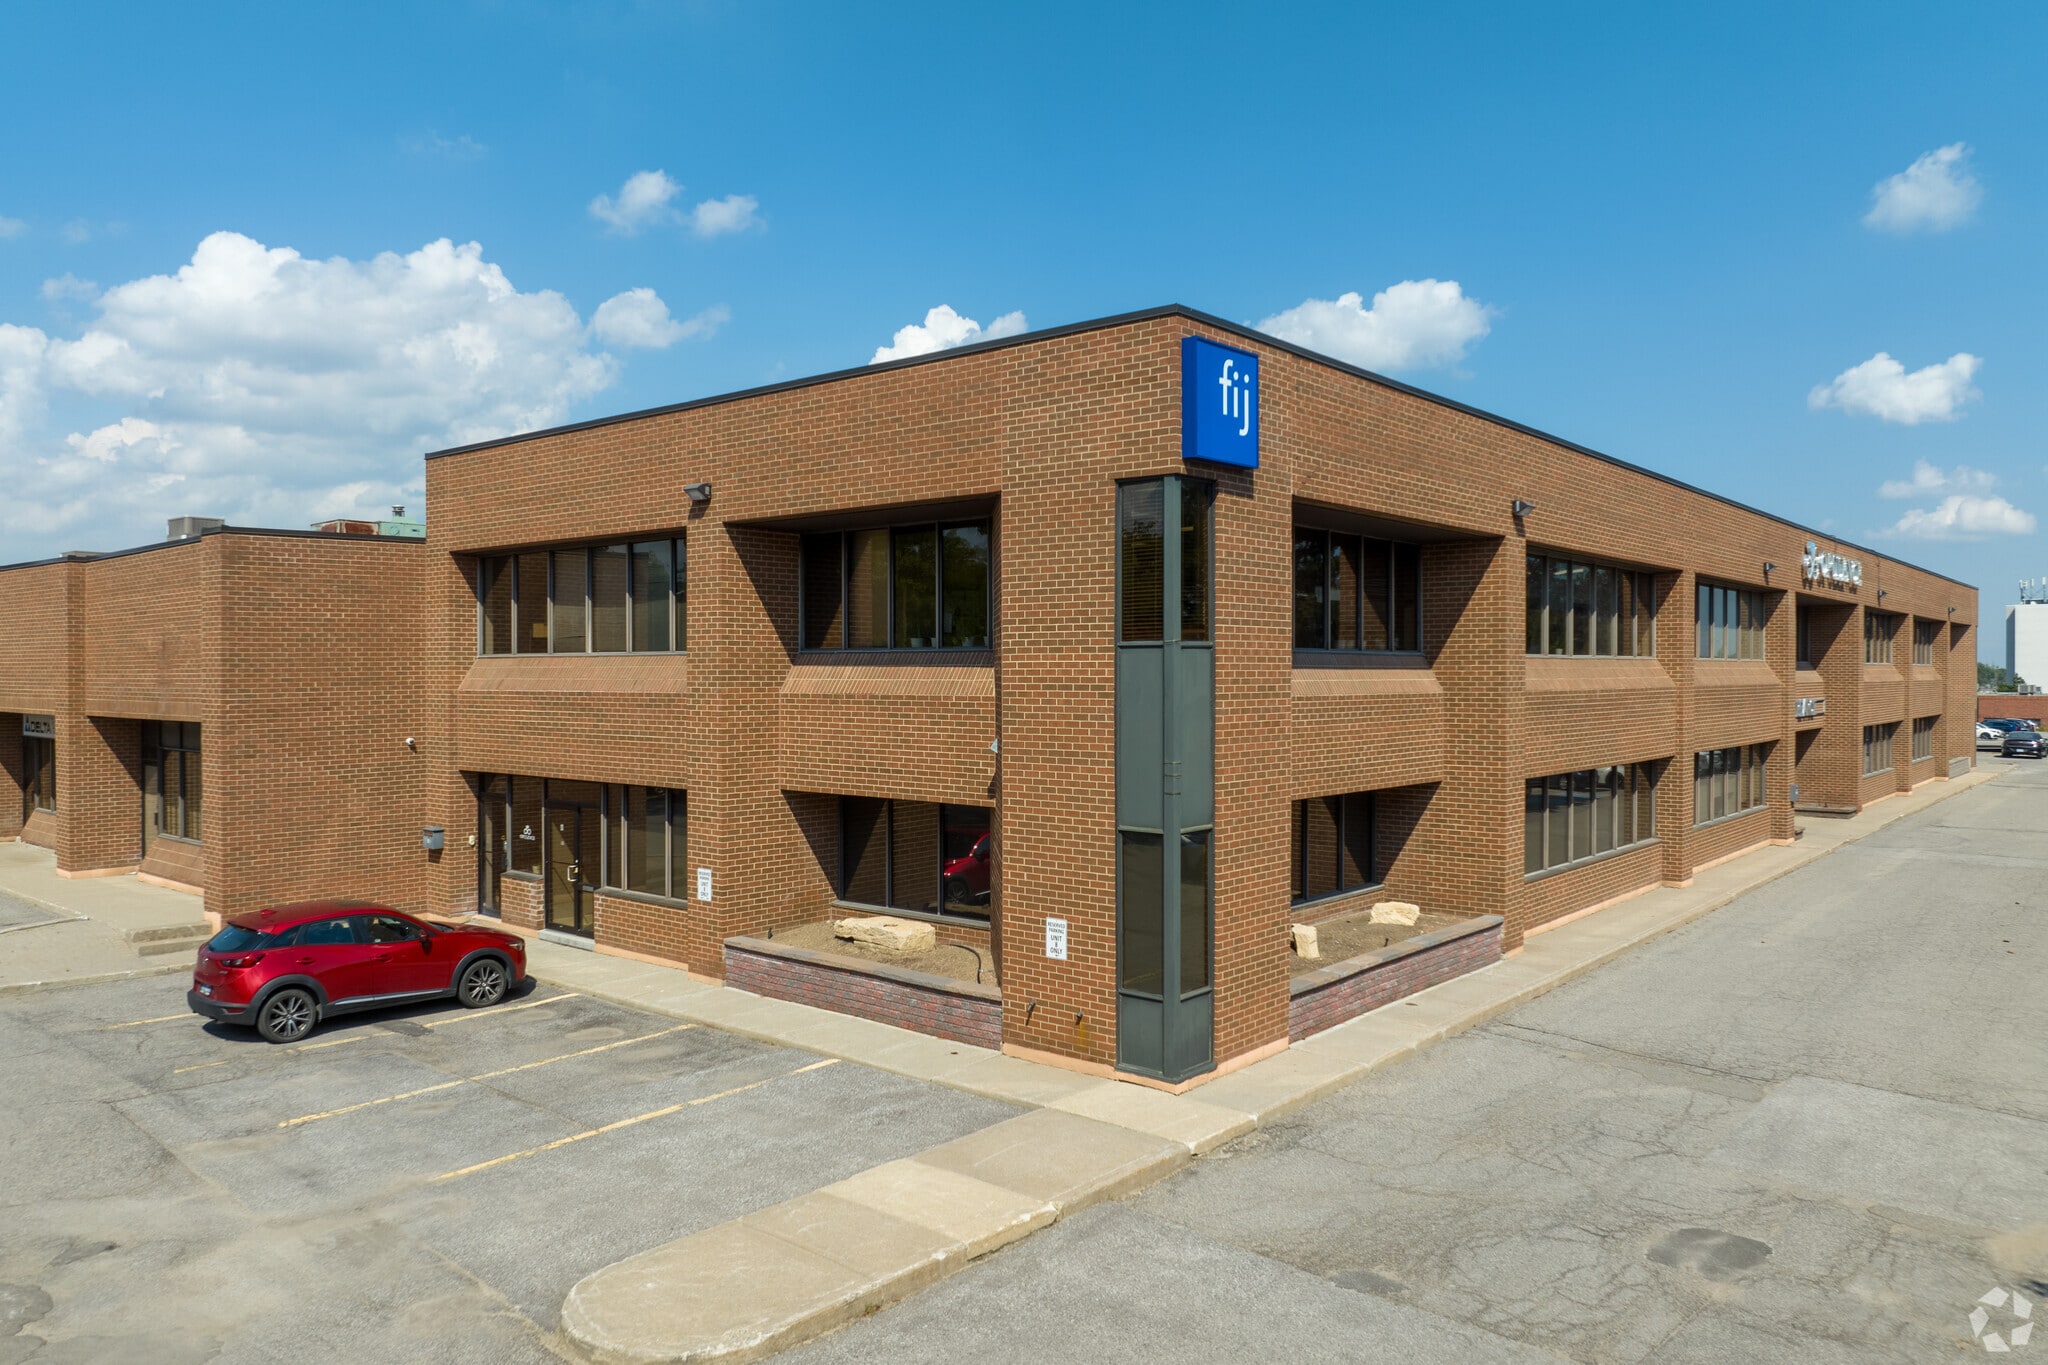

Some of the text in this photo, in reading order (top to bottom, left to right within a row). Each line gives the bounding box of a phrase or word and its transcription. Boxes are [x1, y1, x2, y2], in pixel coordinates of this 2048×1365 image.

[1218, 359, 1250, 436] fij
[31, 721, 50, 733] DELTA
[1050, 947, 1062, 955] ONLY
